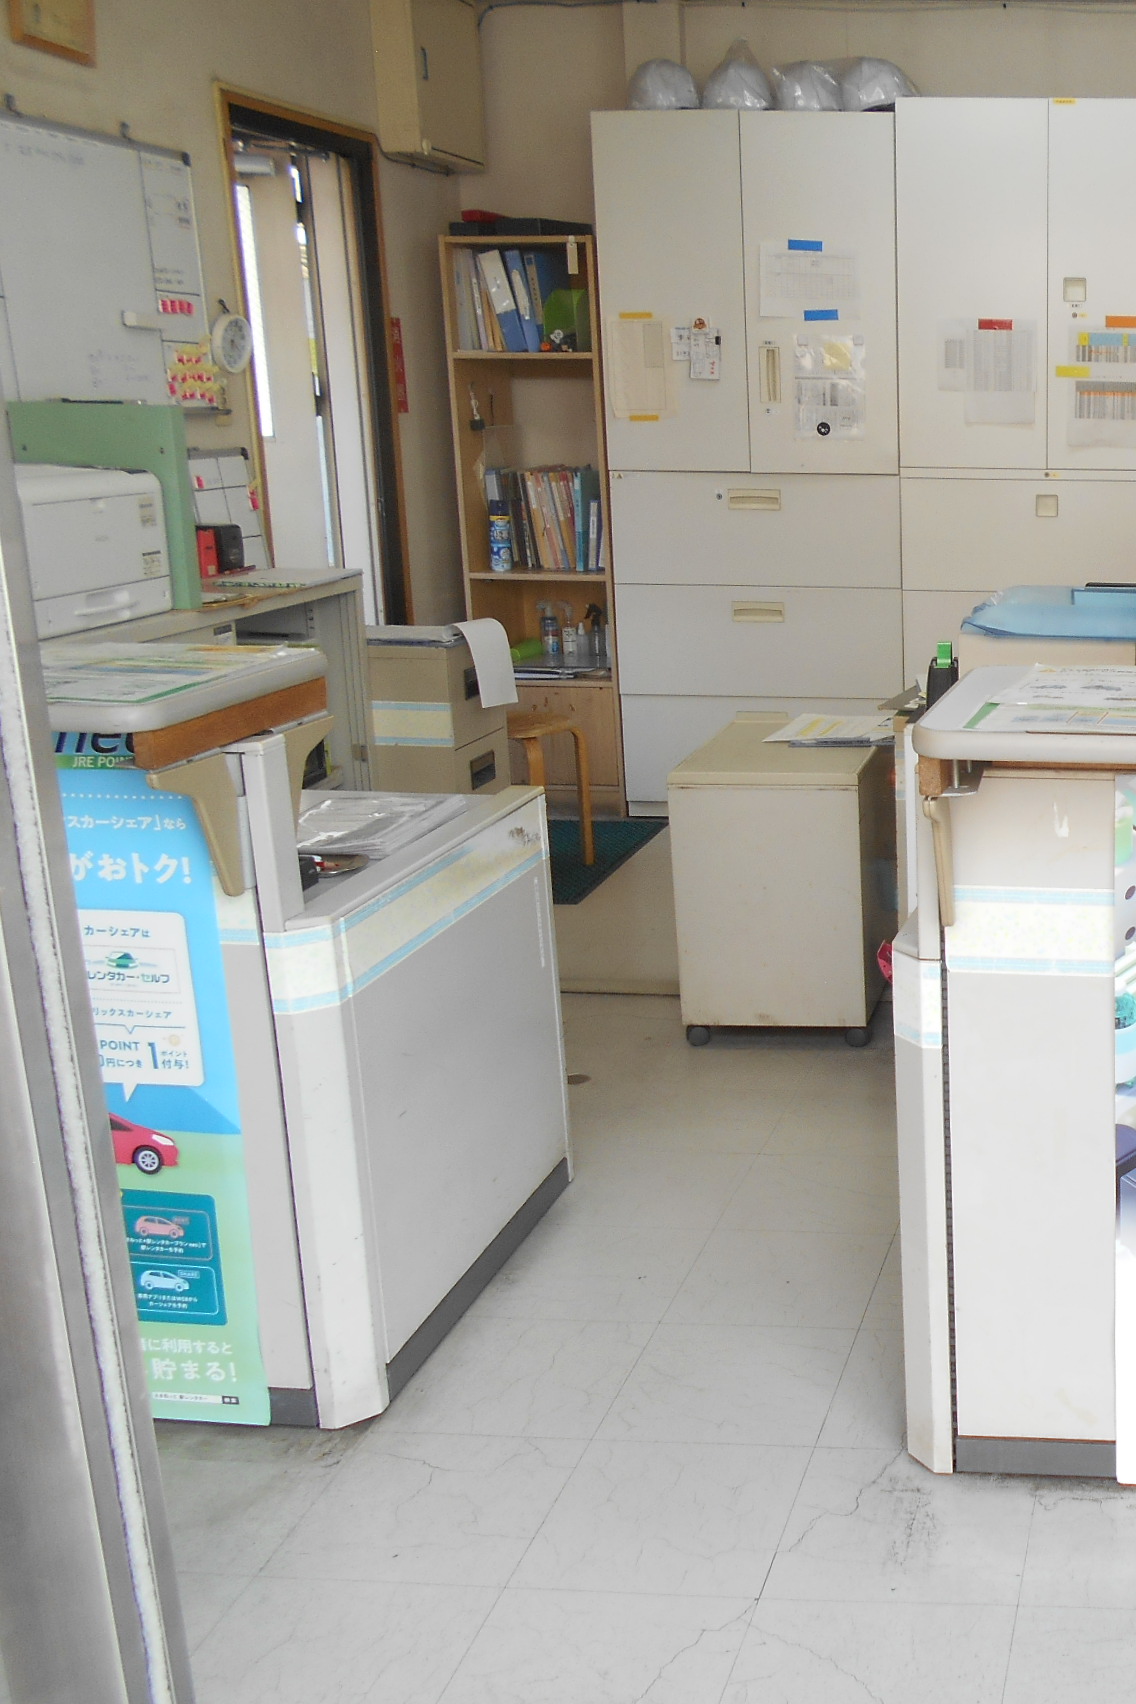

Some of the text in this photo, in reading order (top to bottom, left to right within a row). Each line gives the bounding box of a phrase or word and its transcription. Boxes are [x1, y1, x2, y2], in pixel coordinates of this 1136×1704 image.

[72, 756, 95, 768] JRE
[84, 924, 152, 939] カーシェアは
[100, 1039, 141, 1052] POINT
[147, 1042, 160, 1070] 1
[151, 1357, 237, 1383] 貯まる!
